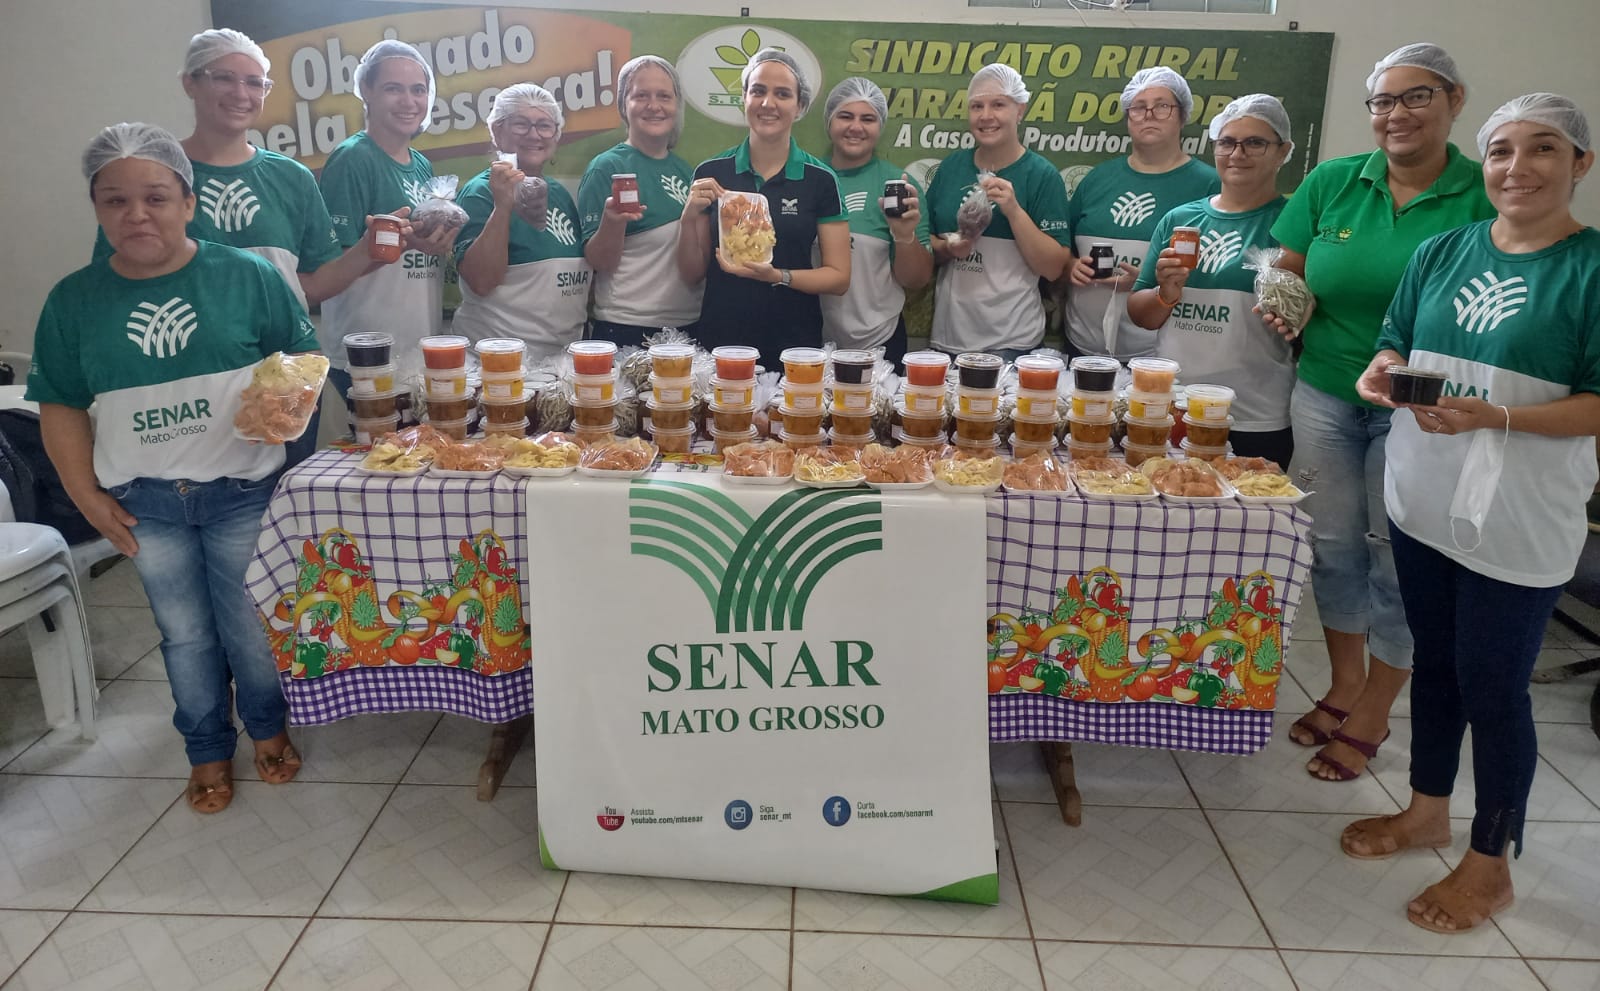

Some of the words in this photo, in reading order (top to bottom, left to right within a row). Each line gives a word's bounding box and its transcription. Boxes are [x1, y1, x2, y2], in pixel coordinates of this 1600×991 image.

[291, 9, 535, 100] Obado
[845, 37, 1082, 78] SINDICATO
[1092, 45, 1240, 81] RURAL
[1067, 91, 1125, 124] DO
[246, 102, 347, 158] ela
[894, 123, 912, 148] A
[1022, 126, 1132, 153] Produtor
[557, 271, 589, 287] SENAR
[1171, 302, 1230, 323] SENAR
[1174, 320, 1193, 331] Mato
[1194, 322, 1223, 334] Grosso
[133, 398, 213, 432] SENAR
[140, 433, 171, 446] Mato
[647, 640, 881, 693] SENAR
[640, 707, 740, 736] MATO
[749, 704, 885, 731] GROSSO
[605, 806, 617, 815] You
[630, 808, 655, 816] Assista
[759, 805, 775, 814] Siga
[857, 801, 875, 810] Curta
[857, 808, 934, 819] facebook.com/senarmt
[603, 817, 619, 826] Tube
[759, 811, 792, 822] senar_mt
